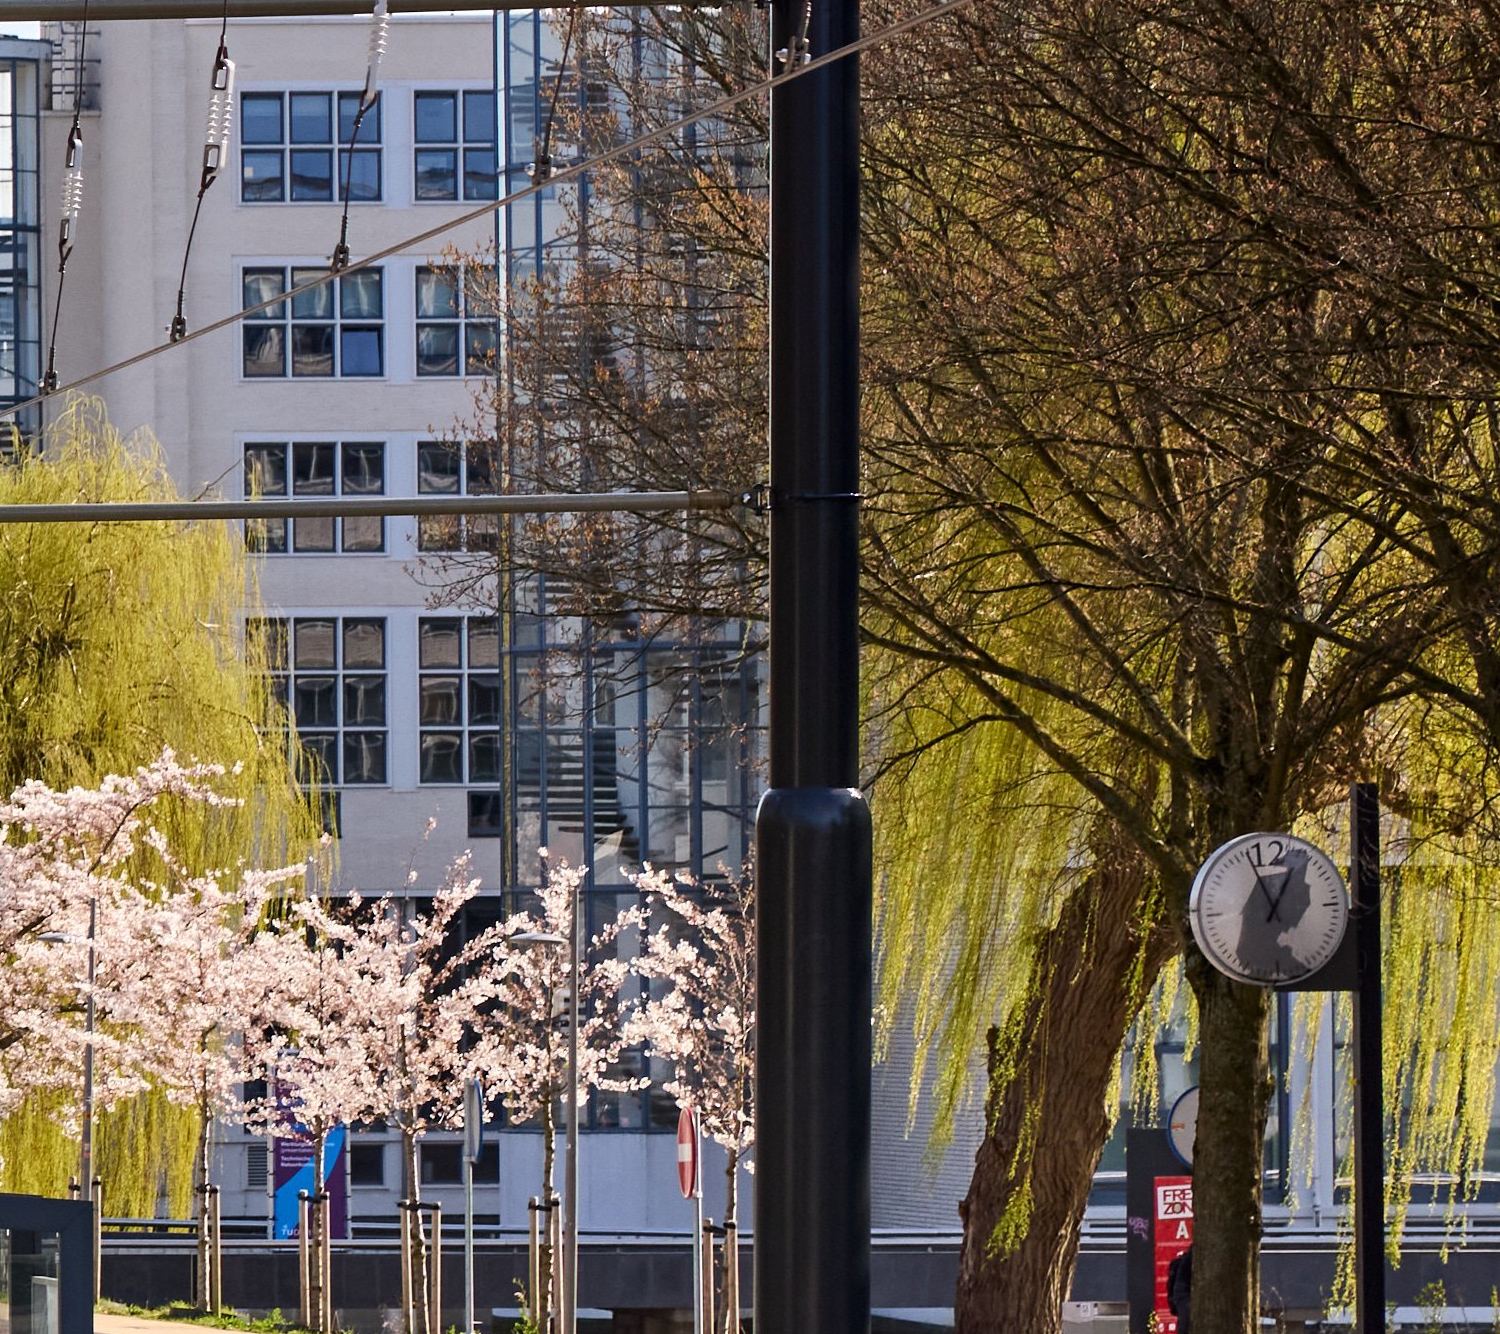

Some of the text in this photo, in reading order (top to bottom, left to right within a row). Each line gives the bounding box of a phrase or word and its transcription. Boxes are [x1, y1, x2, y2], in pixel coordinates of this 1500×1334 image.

[1251, 840, 1284, 867] 12
[1163, 1188, 1192, 1202] FRE
[1164, 1202, 1193, 1215] ZON
[1175, 1220, 1189, 1239] A
